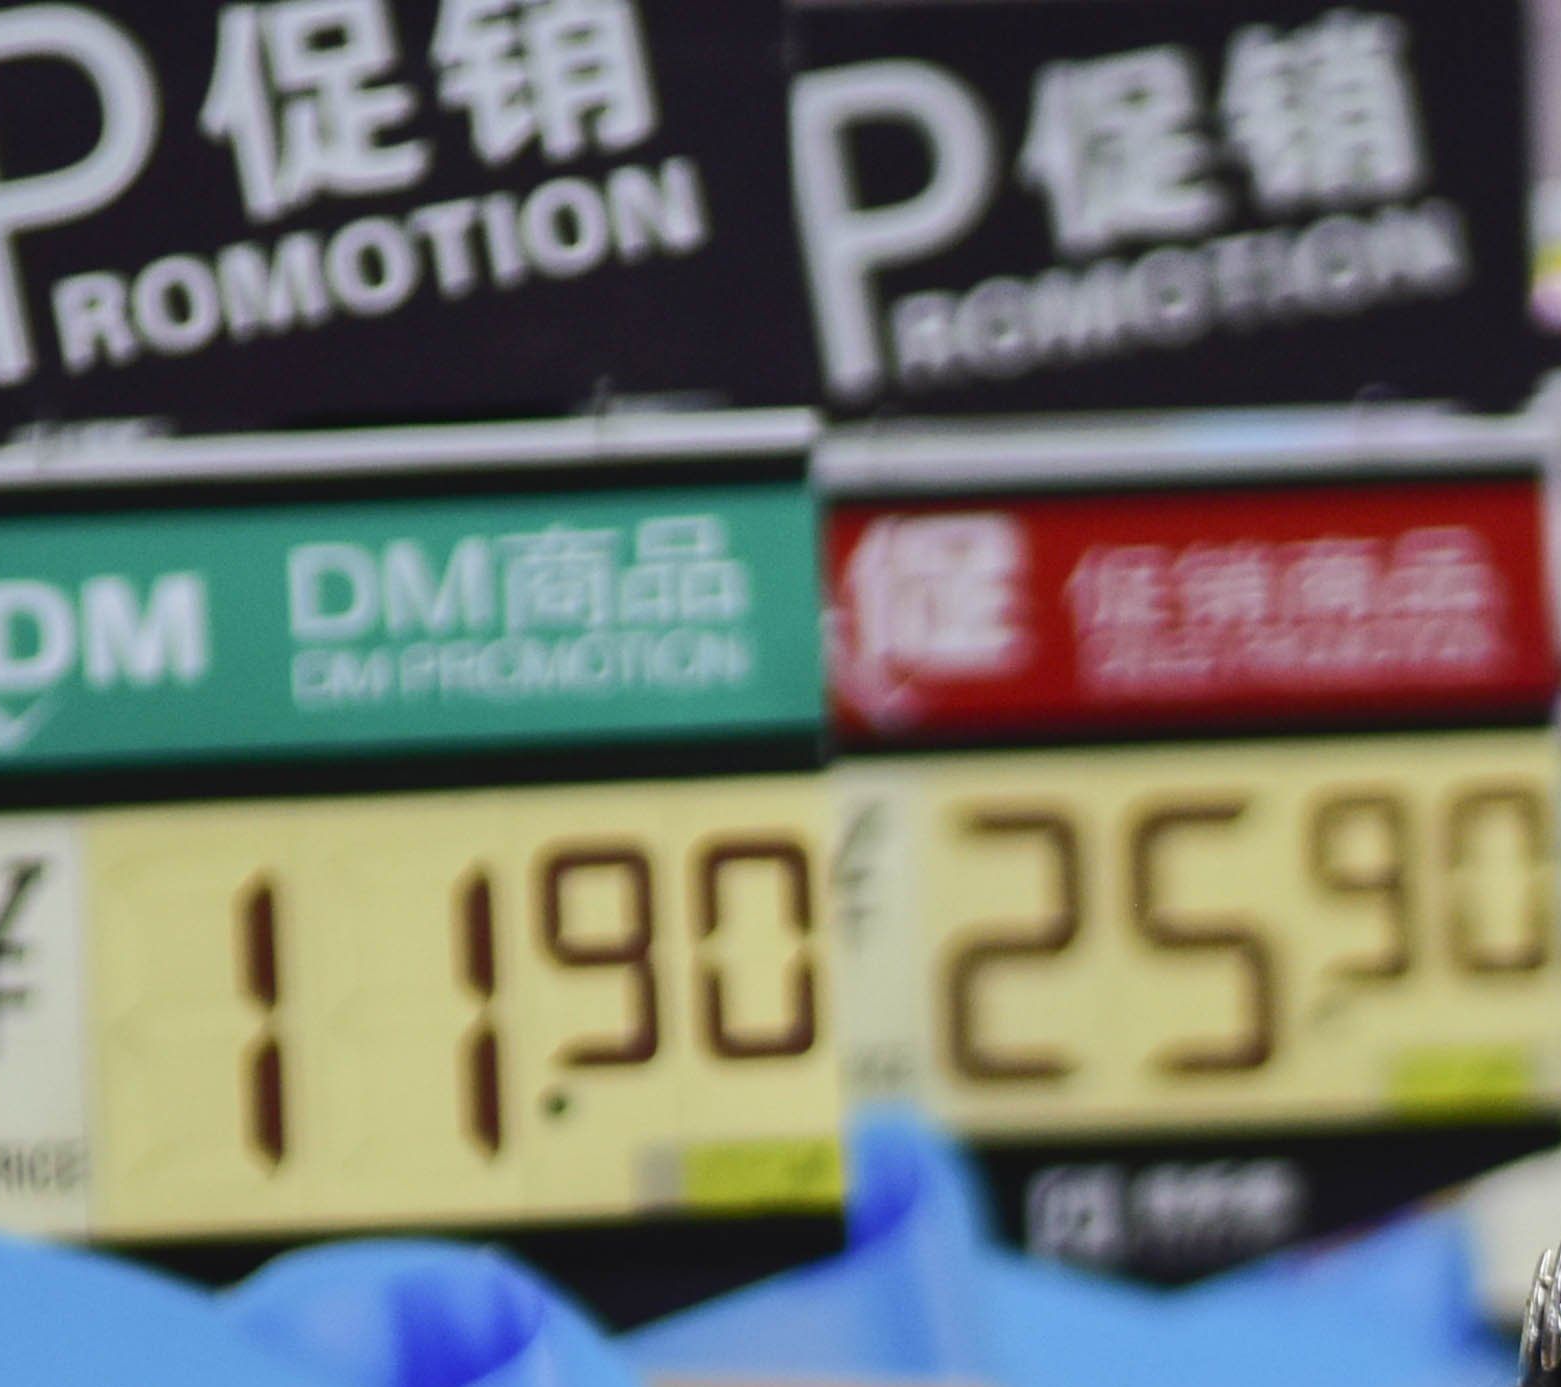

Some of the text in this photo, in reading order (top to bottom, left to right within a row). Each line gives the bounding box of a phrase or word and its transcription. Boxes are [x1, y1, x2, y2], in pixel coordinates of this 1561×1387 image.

[198, 0, 660, 222] 促销
[1020, 8, 1426, 253] 促销
[287, 514, 746, 640] DM商品
[234, 836, 818, 1170] 11.90
